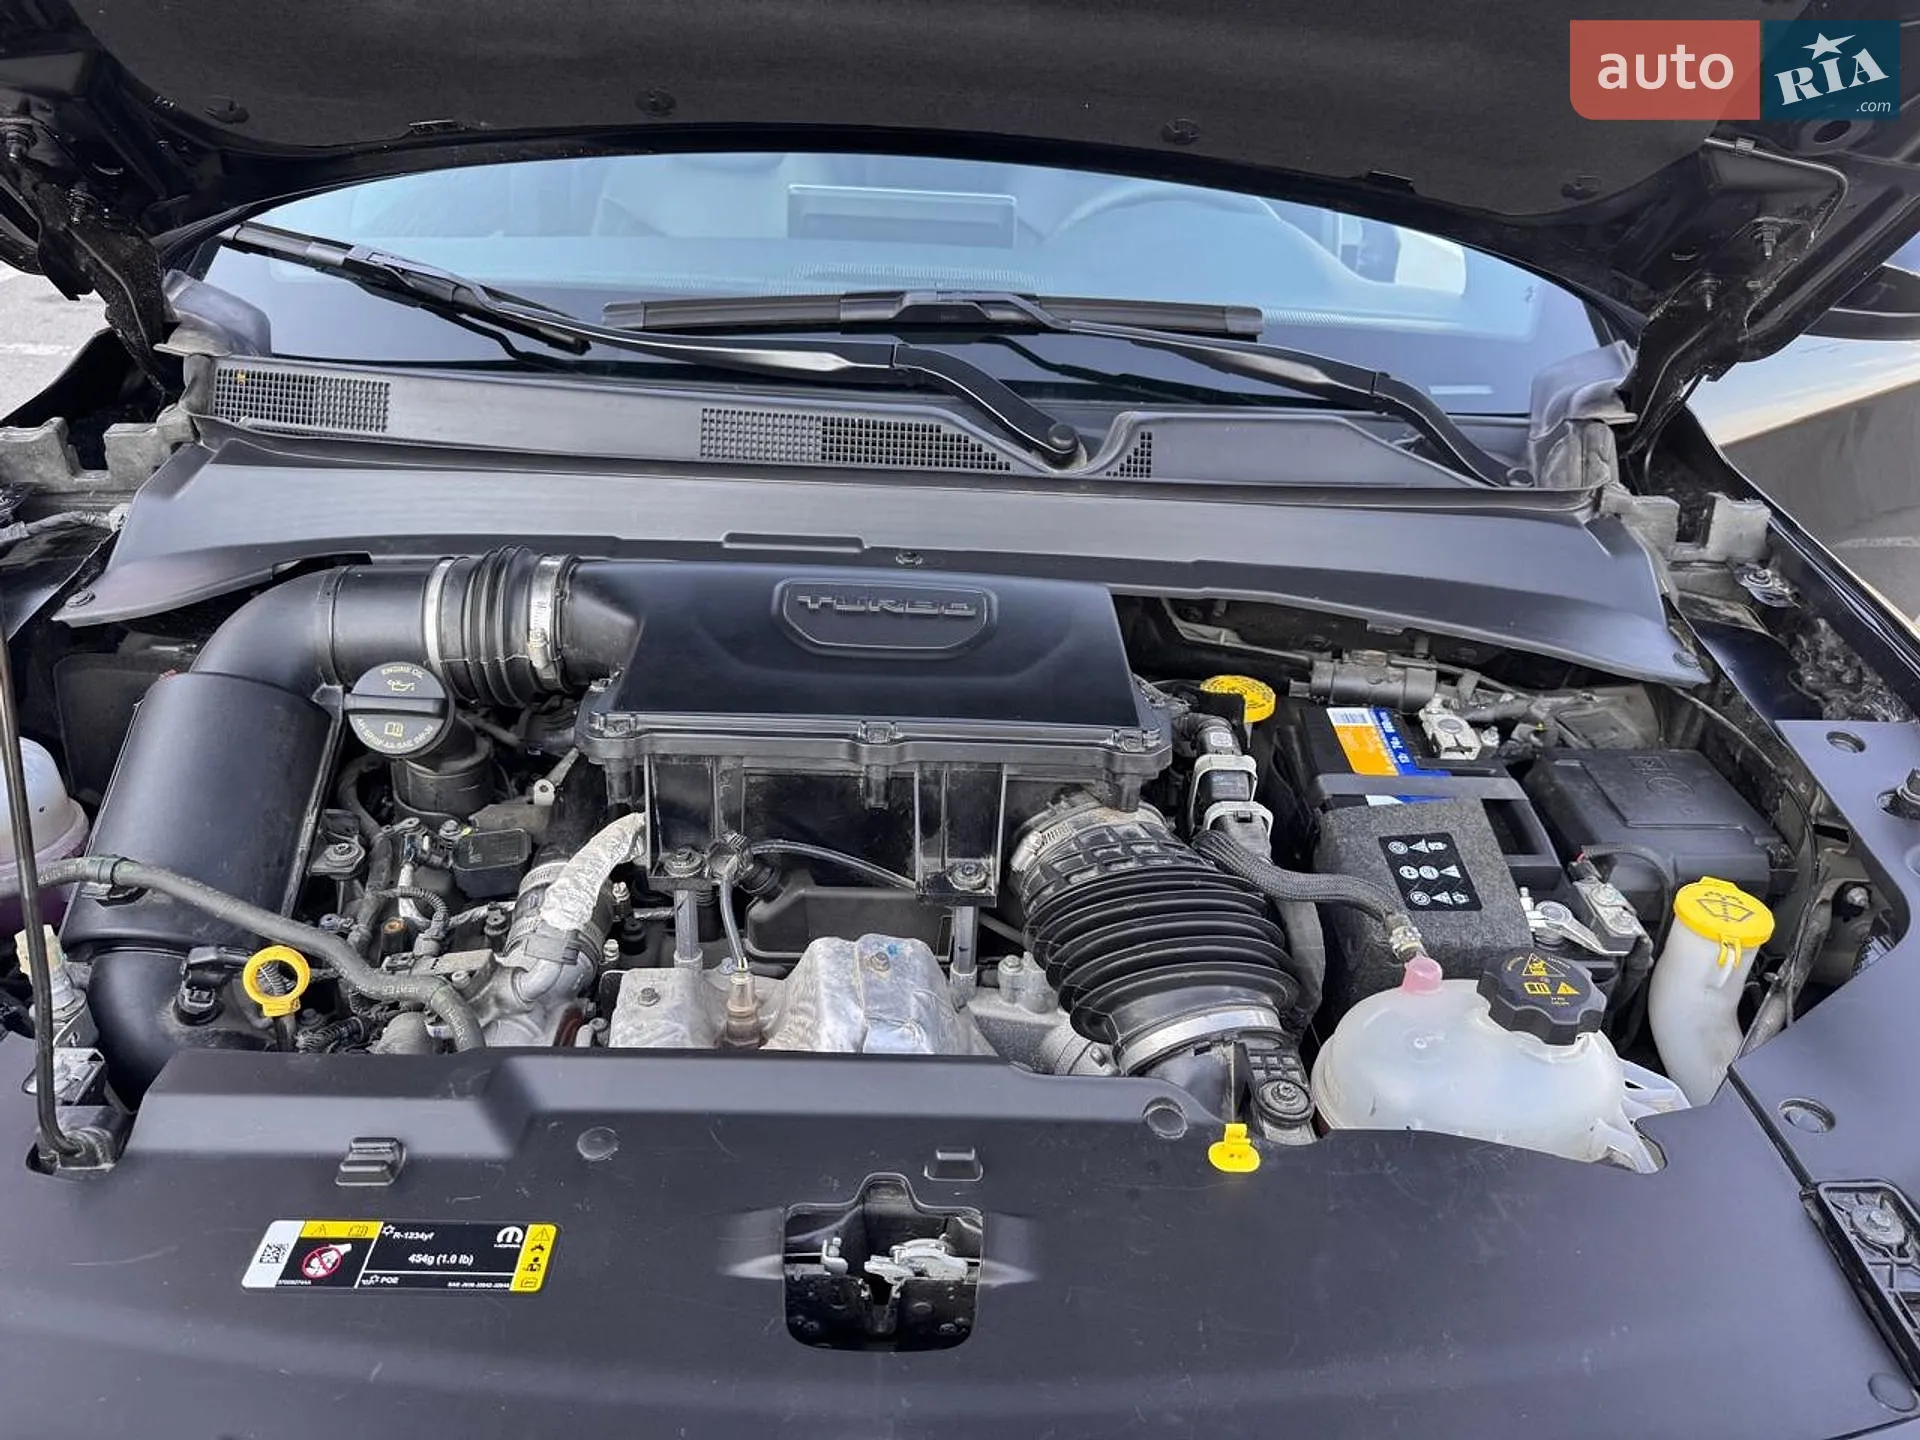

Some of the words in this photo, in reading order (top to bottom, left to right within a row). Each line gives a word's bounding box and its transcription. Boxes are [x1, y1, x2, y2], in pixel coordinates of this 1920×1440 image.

[797, 594, 977, 617] TURBO
[408, 1253, 435, 1266] 454g
[436, 1253, 458, 1266] (1.0
[458, 1253, 474, 1266] lb)
